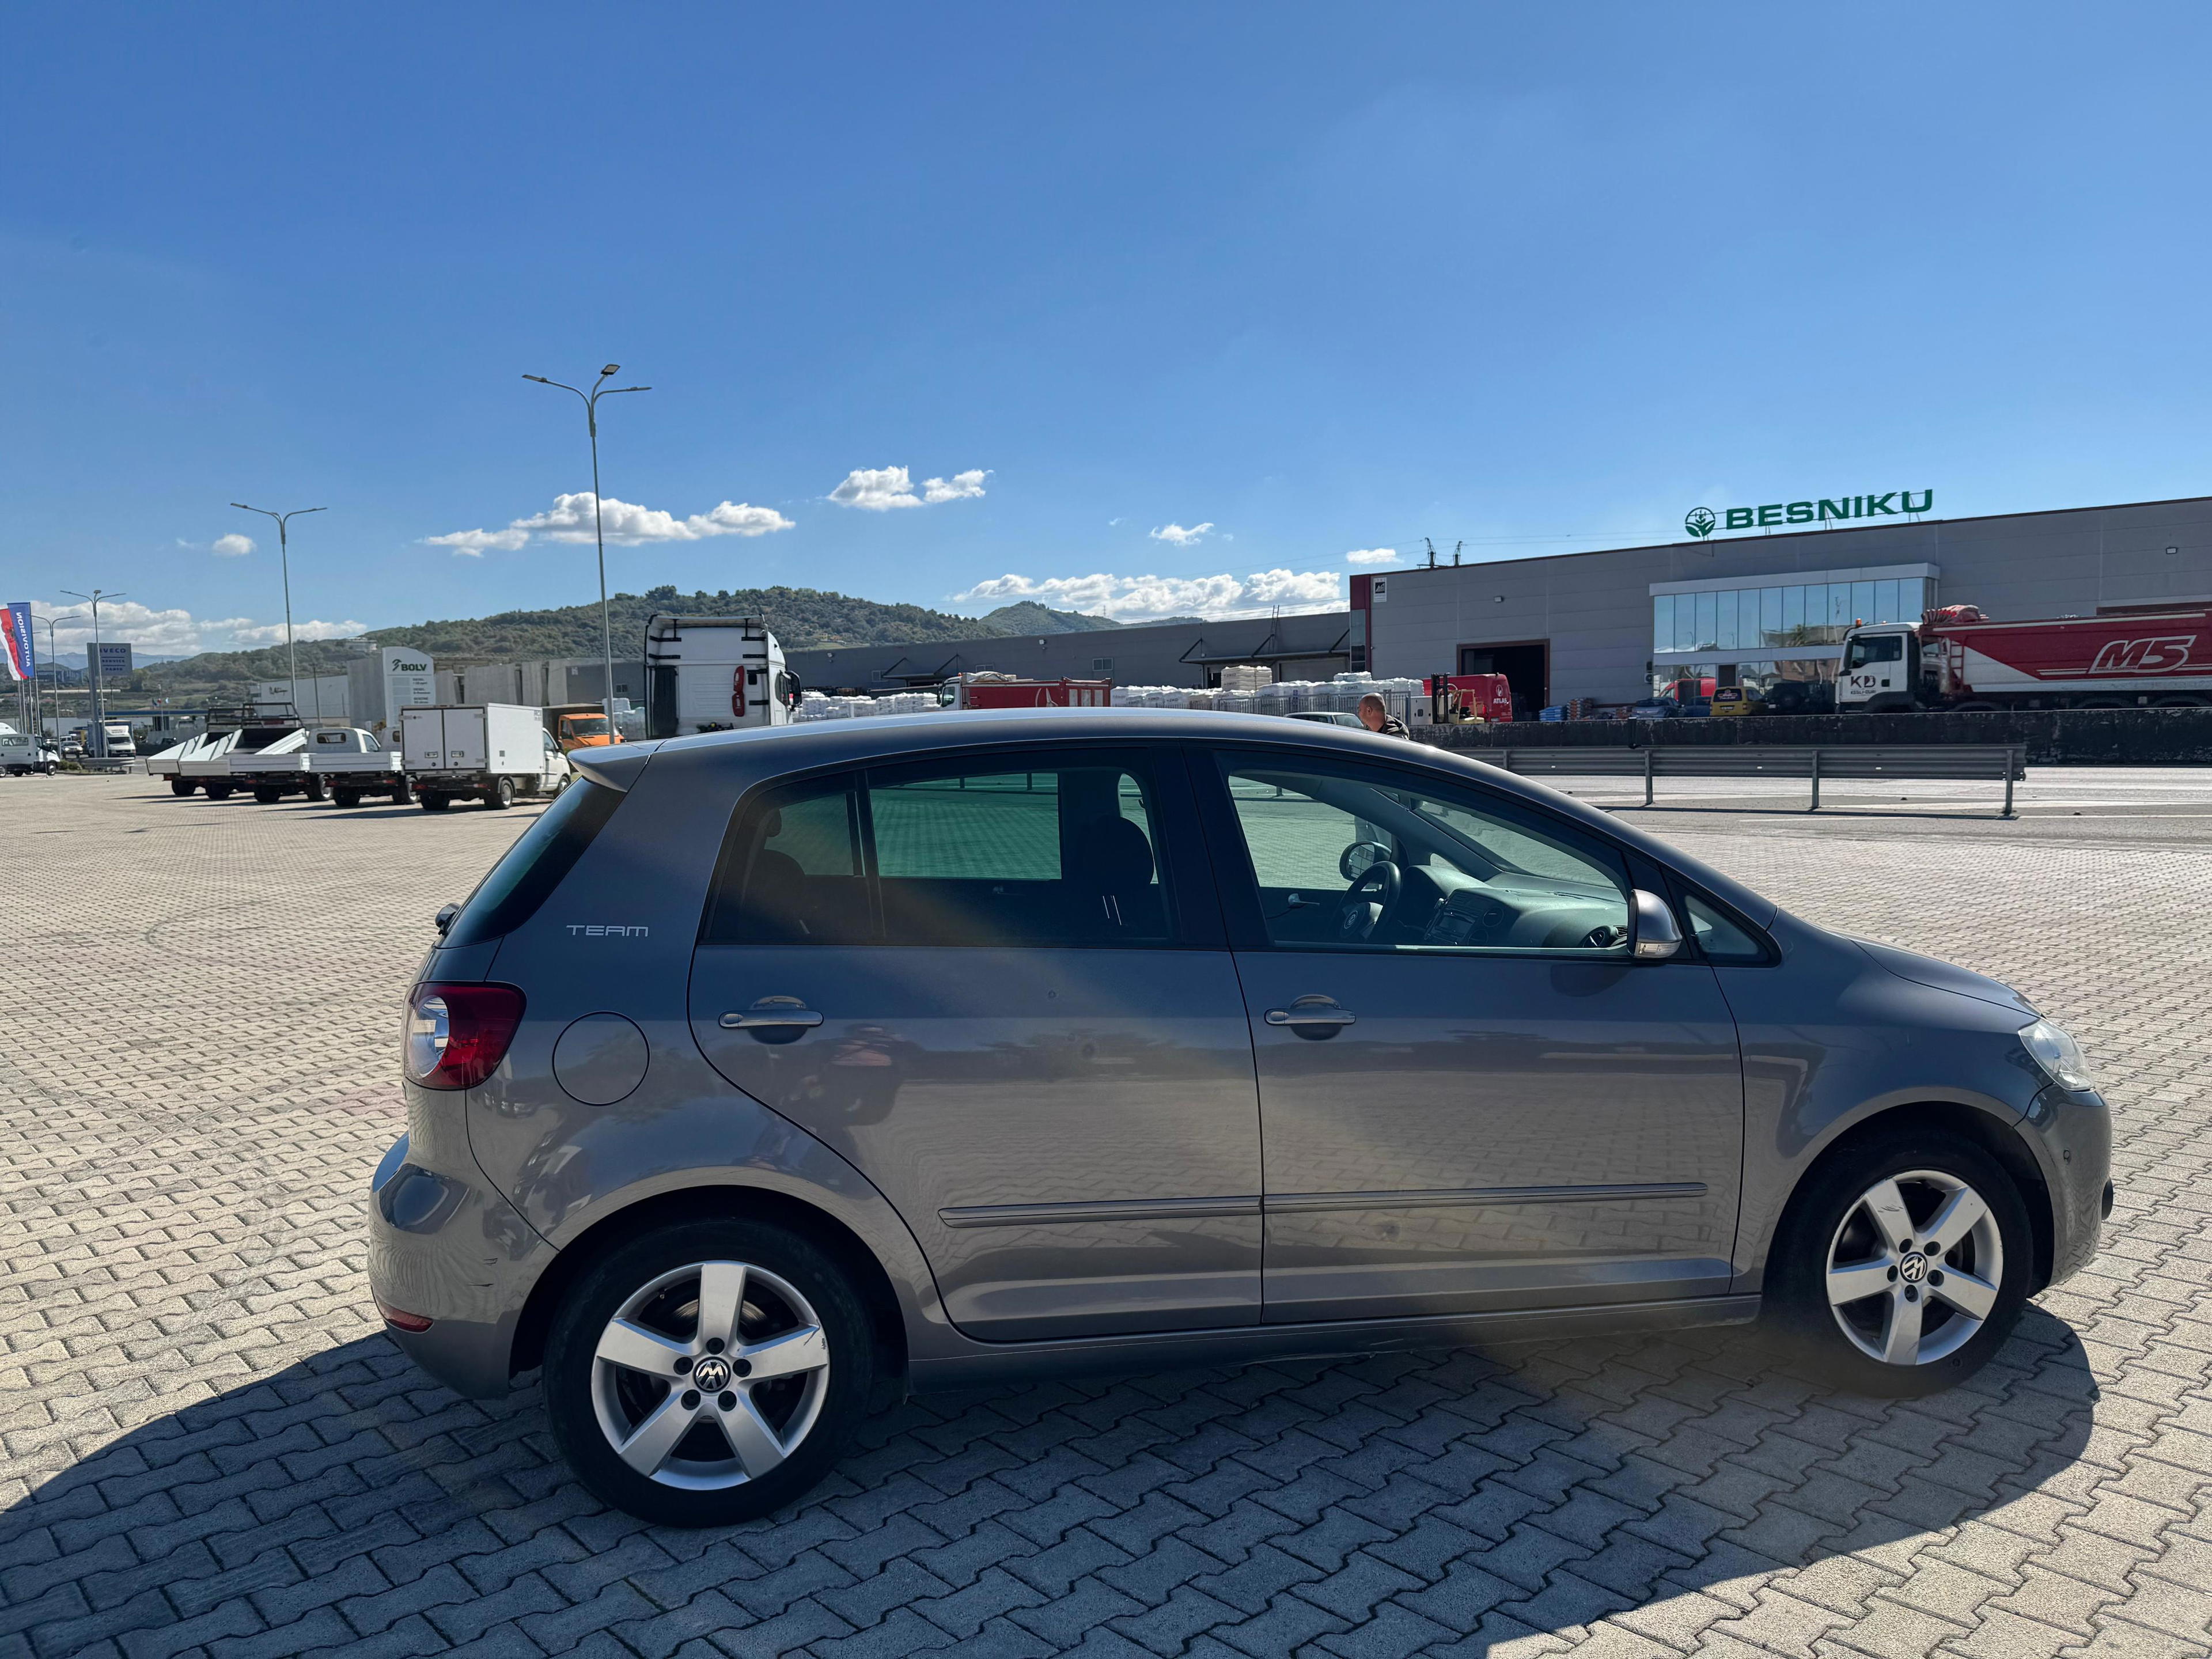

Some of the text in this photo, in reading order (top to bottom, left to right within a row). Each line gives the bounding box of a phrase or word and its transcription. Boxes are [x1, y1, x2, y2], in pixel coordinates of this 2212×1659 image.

[1726, 489, 1933, 530] BESNIKU
[2088, 635, 2198, 674] M5
[566, 925, 649, 937] TEAM
